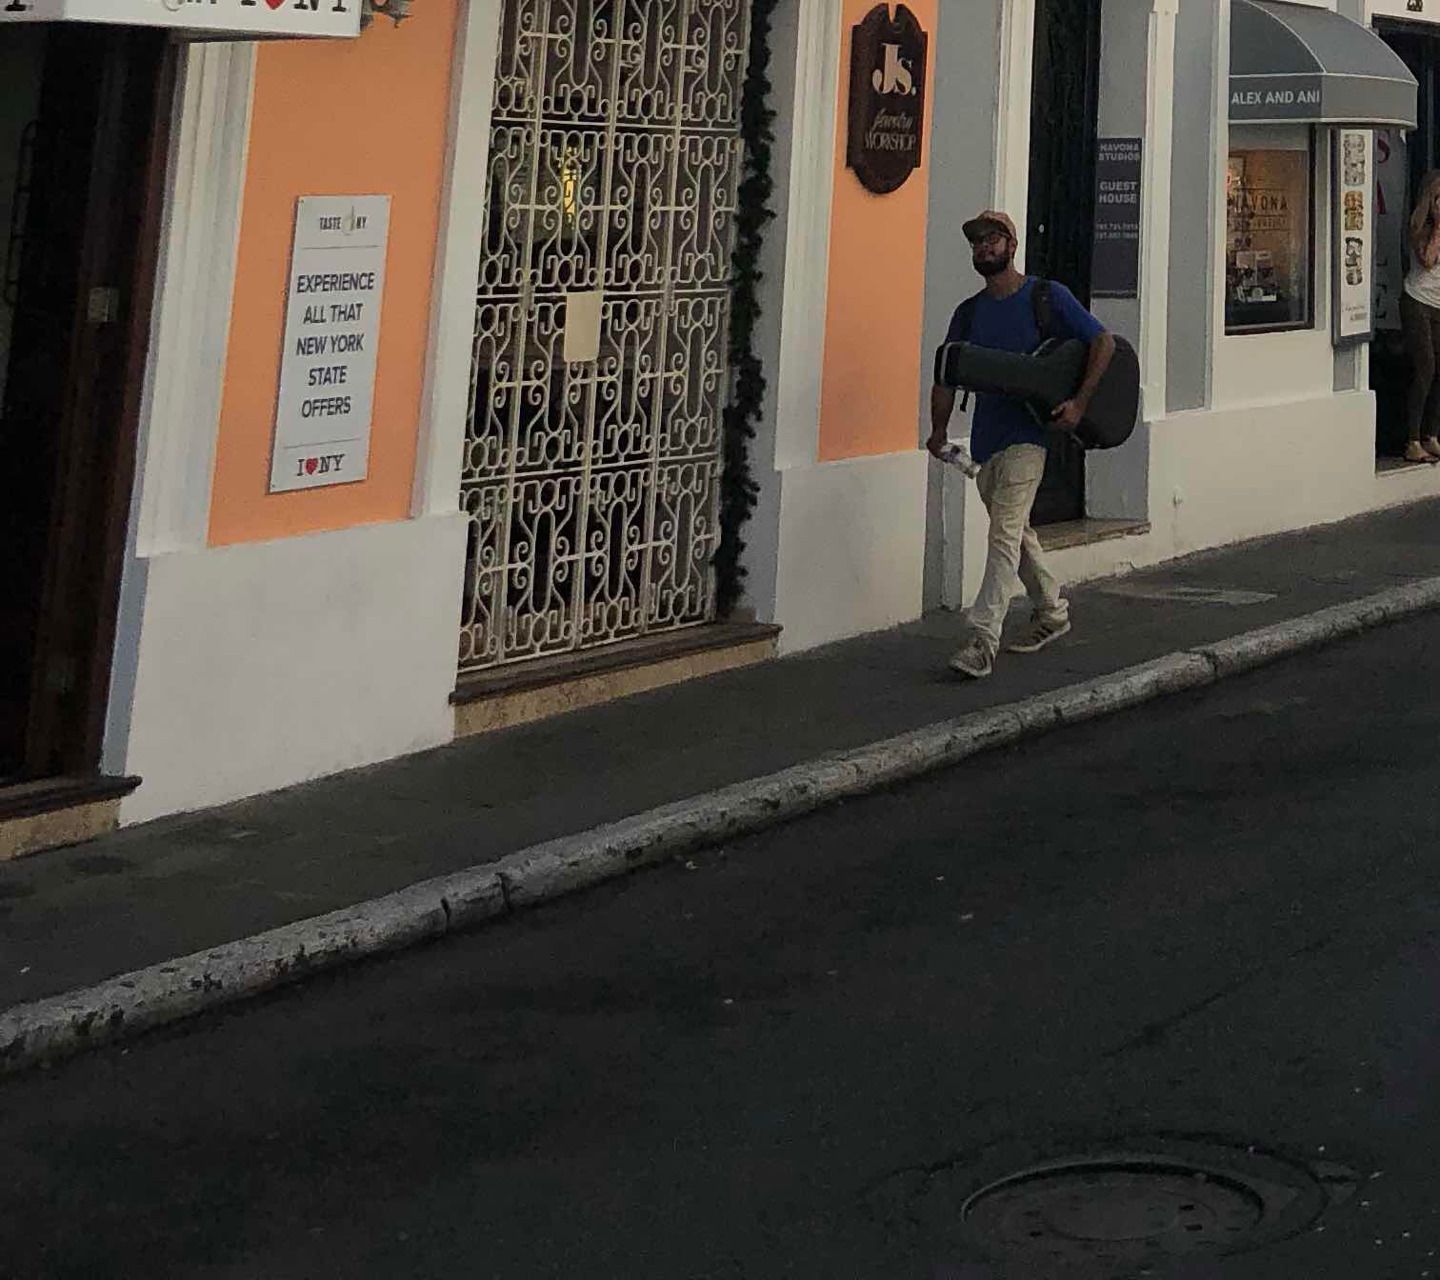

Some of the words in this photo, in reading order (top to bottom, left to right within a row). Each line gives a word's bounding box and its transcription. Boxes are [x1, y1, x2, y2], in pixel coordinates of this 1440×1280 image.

[1231, 90, 1262, 105] ALEX
[1265, 90, 1294, 104] AND
[1297, 89, 1320, 103] ANI
[1100, 181, 1137, 191] GUEST
[1099, 193, 1137, 203] HOUSE
[320, 216, 341, 231] TASTE
[356, 216, 367, 230] NY
[297, 272, 375, 294] EXPERIENCE
[303, 304, 327, 324] ALL
[330, 303, 363, 322] THAT
[296, 337, 325, 355] NEW
[326, 333, 364, 353] YORK
[308, 365, 347, 386] STATE
[301, 395, 351, 418] OFFERS
